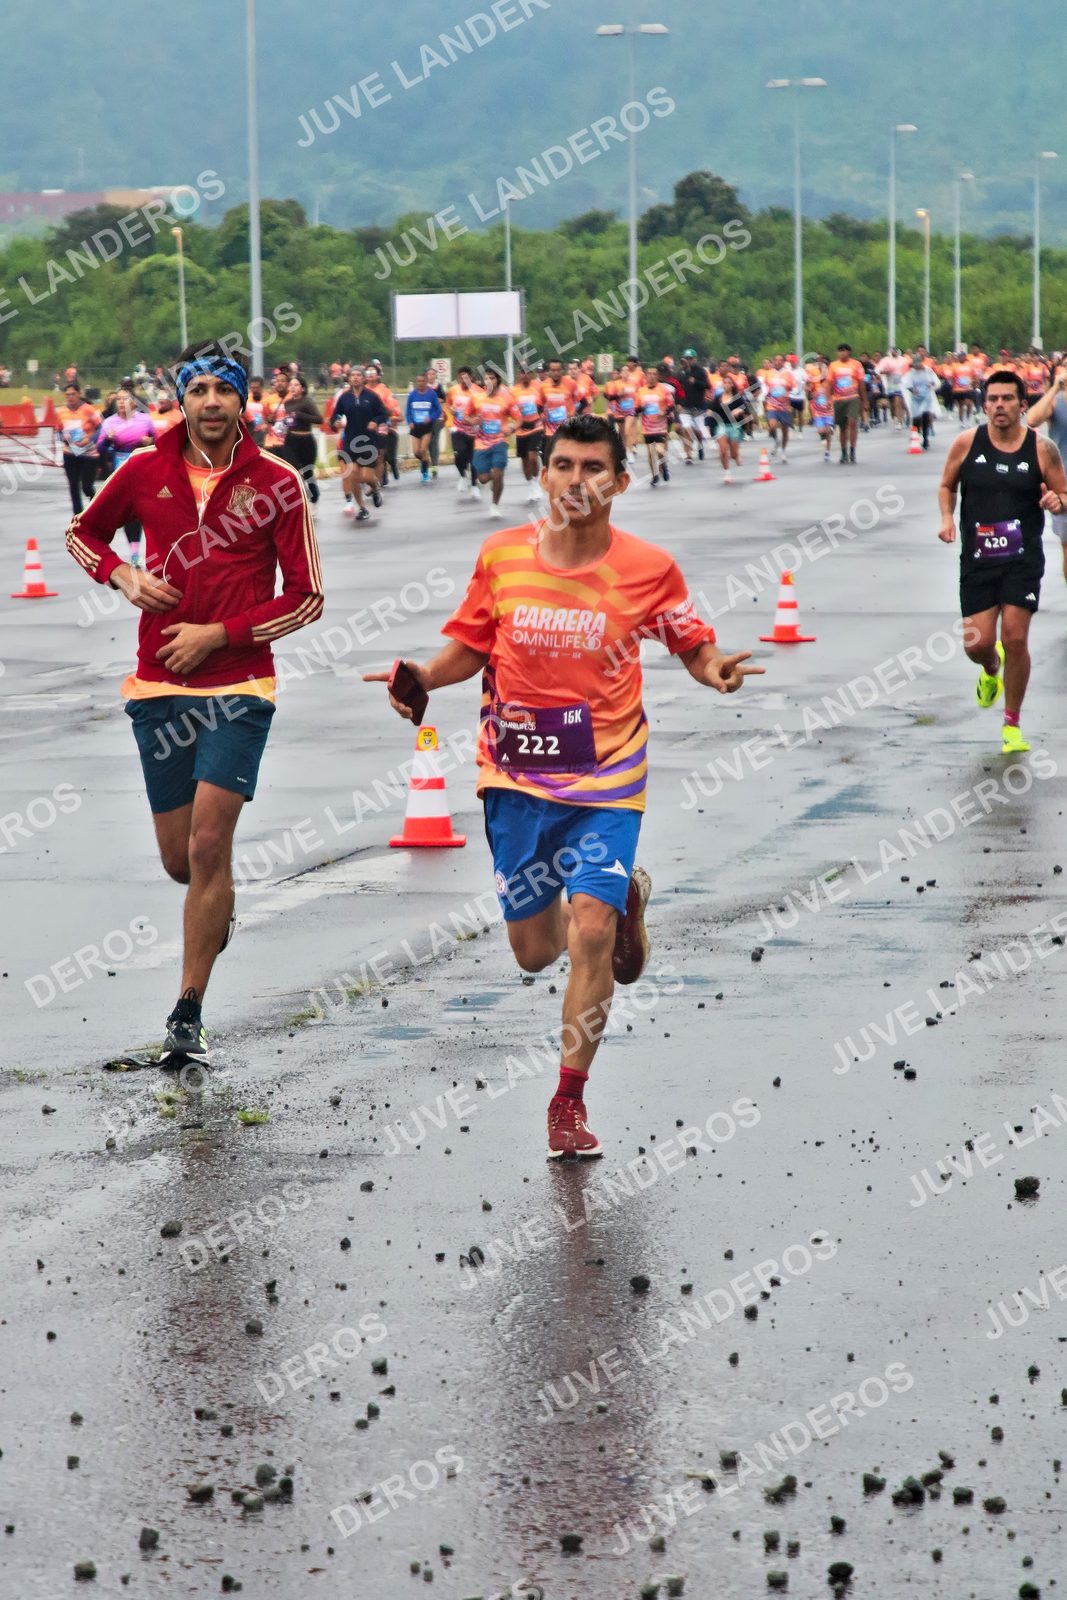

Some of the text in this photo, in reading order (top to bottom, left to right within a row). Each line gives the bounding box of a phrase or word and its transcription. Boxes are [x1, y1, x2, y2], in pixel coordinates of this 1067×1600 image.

[984, 536, 1008, 549] 420
[512, 604, 606, 634] CARRERA
[512, 630, 582, 649] OMNILIFE
[517, 734, 560, 755] 222
